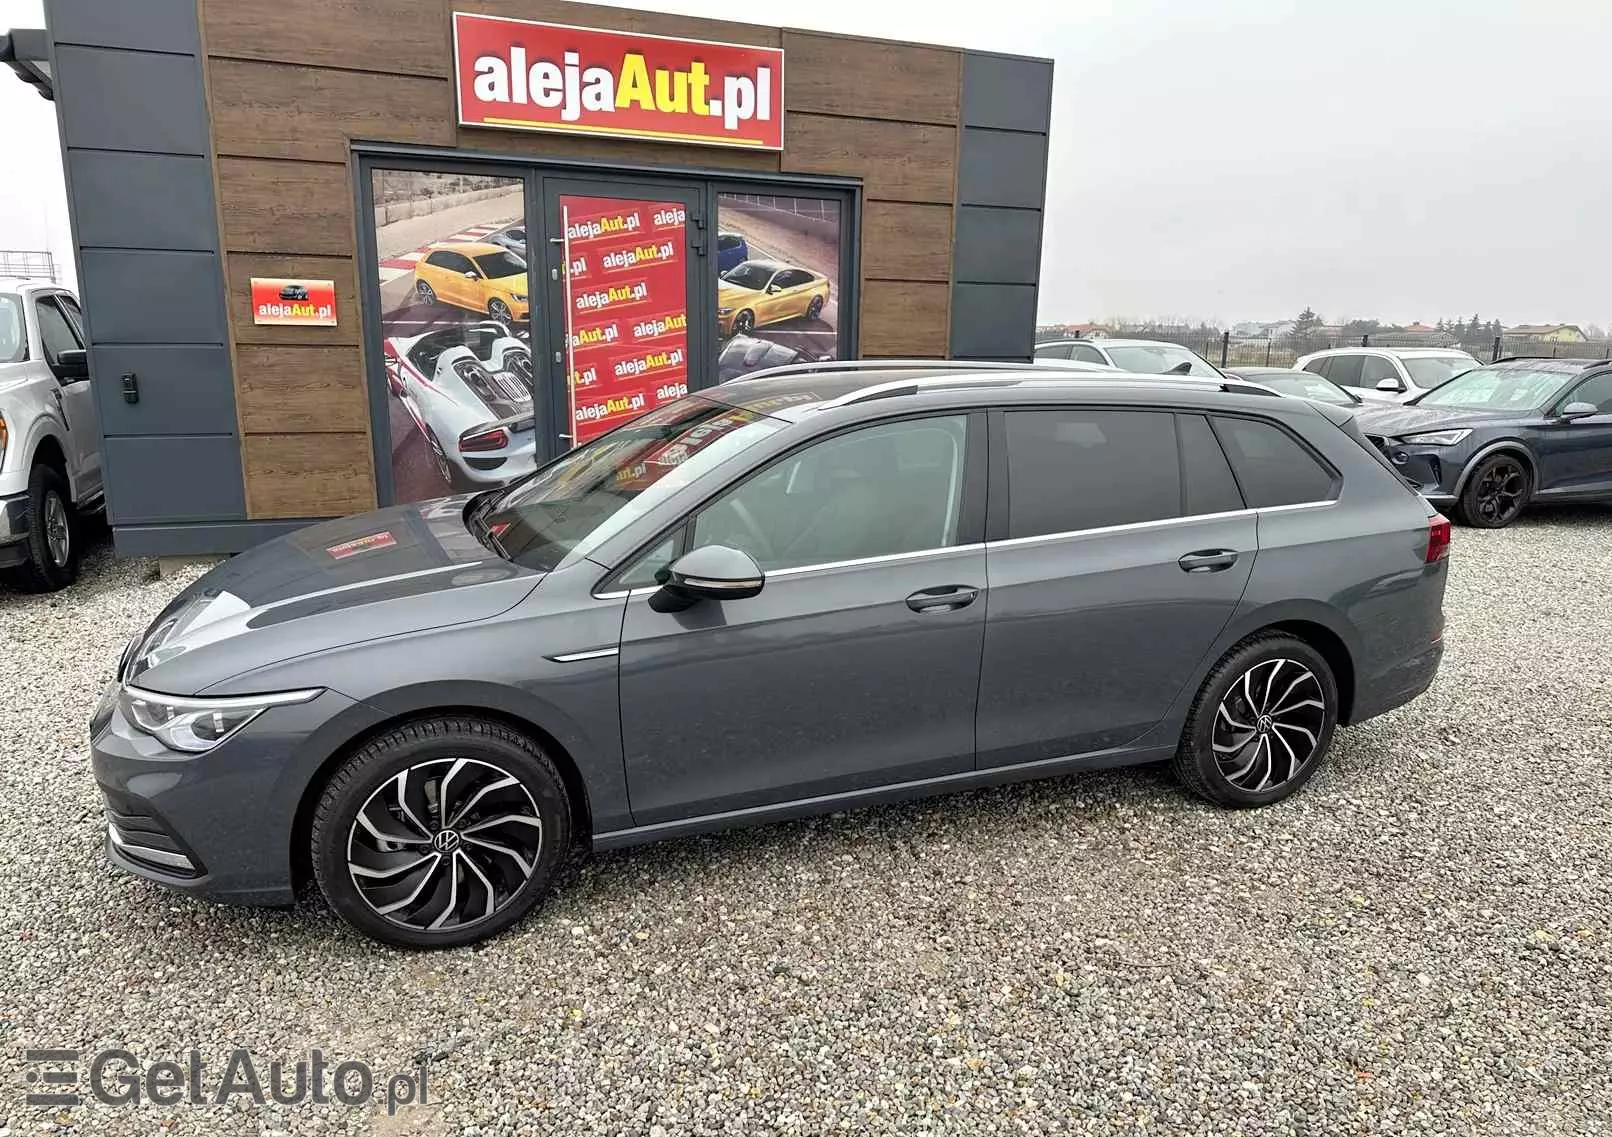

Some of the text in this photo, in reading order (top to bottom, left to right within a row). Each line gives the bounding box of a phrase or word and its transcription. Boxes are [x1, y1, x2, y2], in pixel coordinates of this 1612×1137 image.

[473, 45, 771, 130] alejaAut.pl
[568, 212, 640, 239] alejaAut.pl
[653, 207, 686, 225] aleja
[602, 241, 674, 268] alejaAut.pl
[576, 282, 648, 309] alejaAut.pl
[258, 303, 332, 320] alejaAut.pl
[614, 349, 683, 376] alejaAut.pl
[656, 382, 688, 400] aleja
[575, 393, 645, 421] alejaAut.pl
